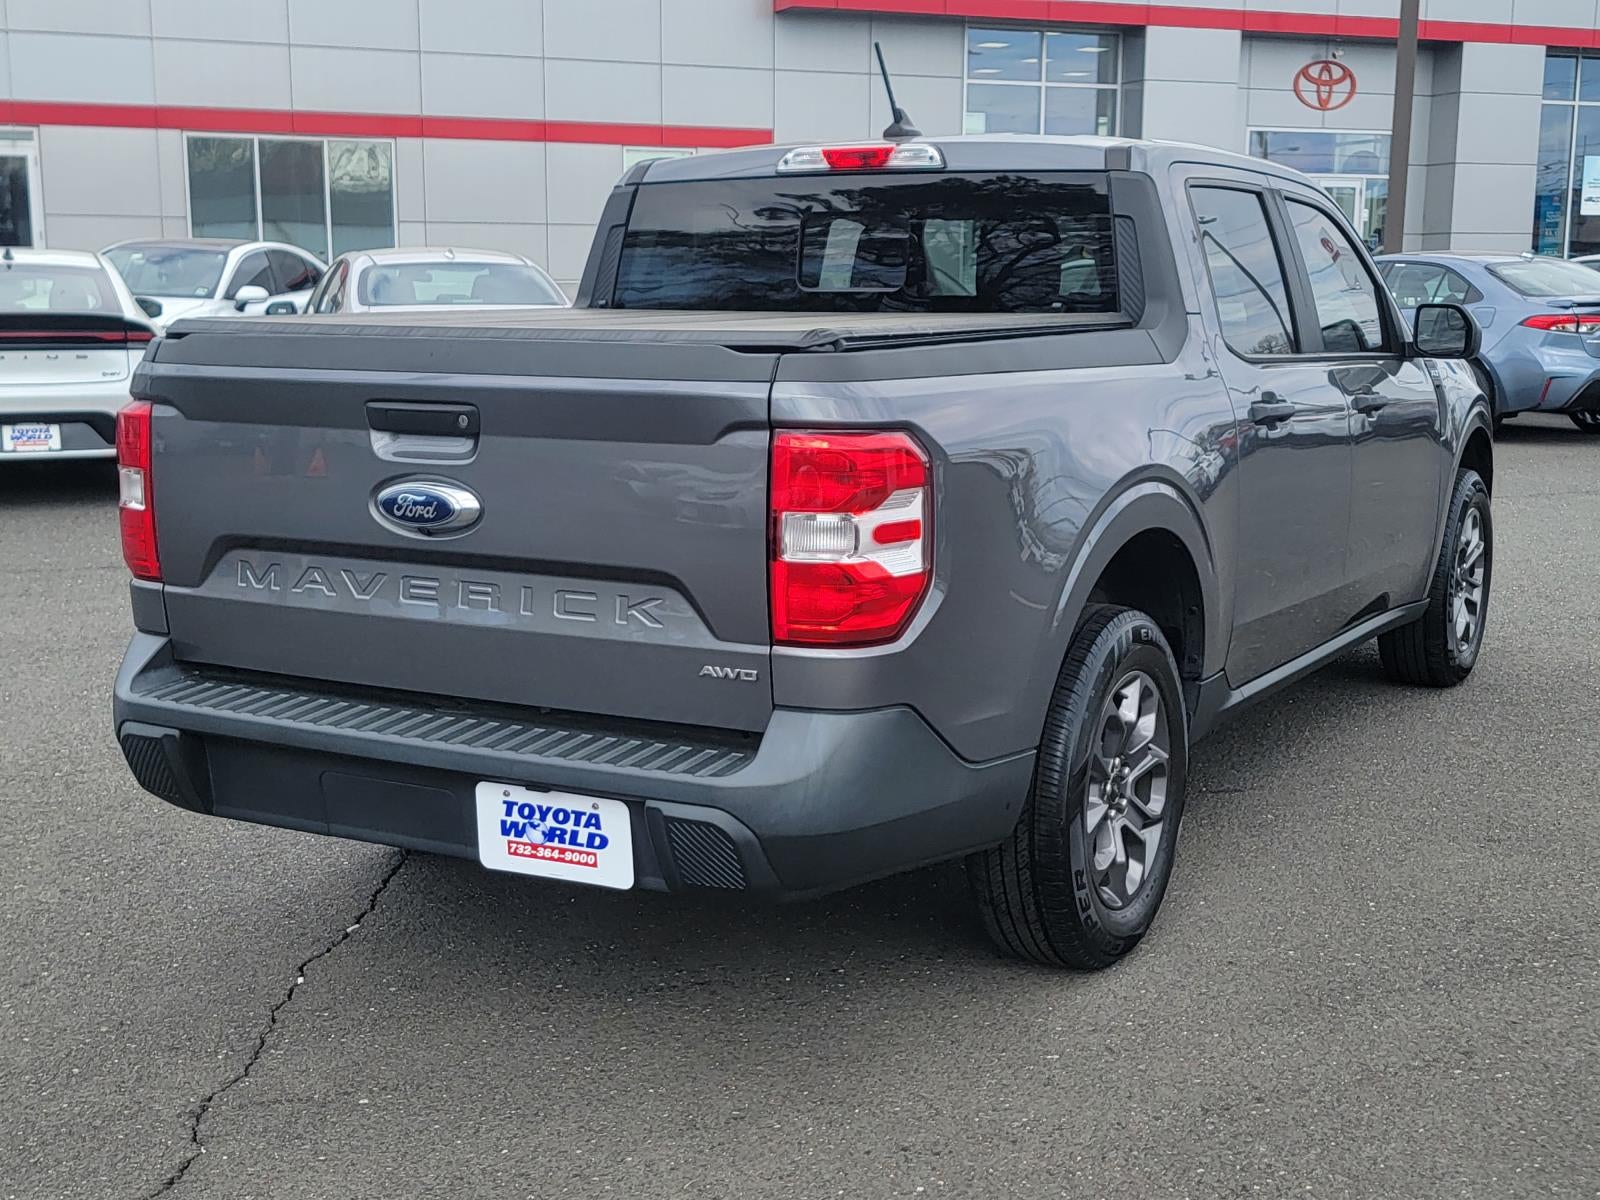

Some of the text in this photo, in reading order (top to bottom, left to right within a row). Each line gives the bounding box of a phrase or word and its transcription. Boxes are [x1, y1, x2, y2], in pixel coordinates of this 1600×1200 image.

[393, 493, 438, 519] Ford
[236, 560, 665, 629] MAVERICK
[699, 665, 758, 681] AWD
[502, 800, 602, 831] TOYOTA
[508, 843, 596, 865] 732-364-9000
